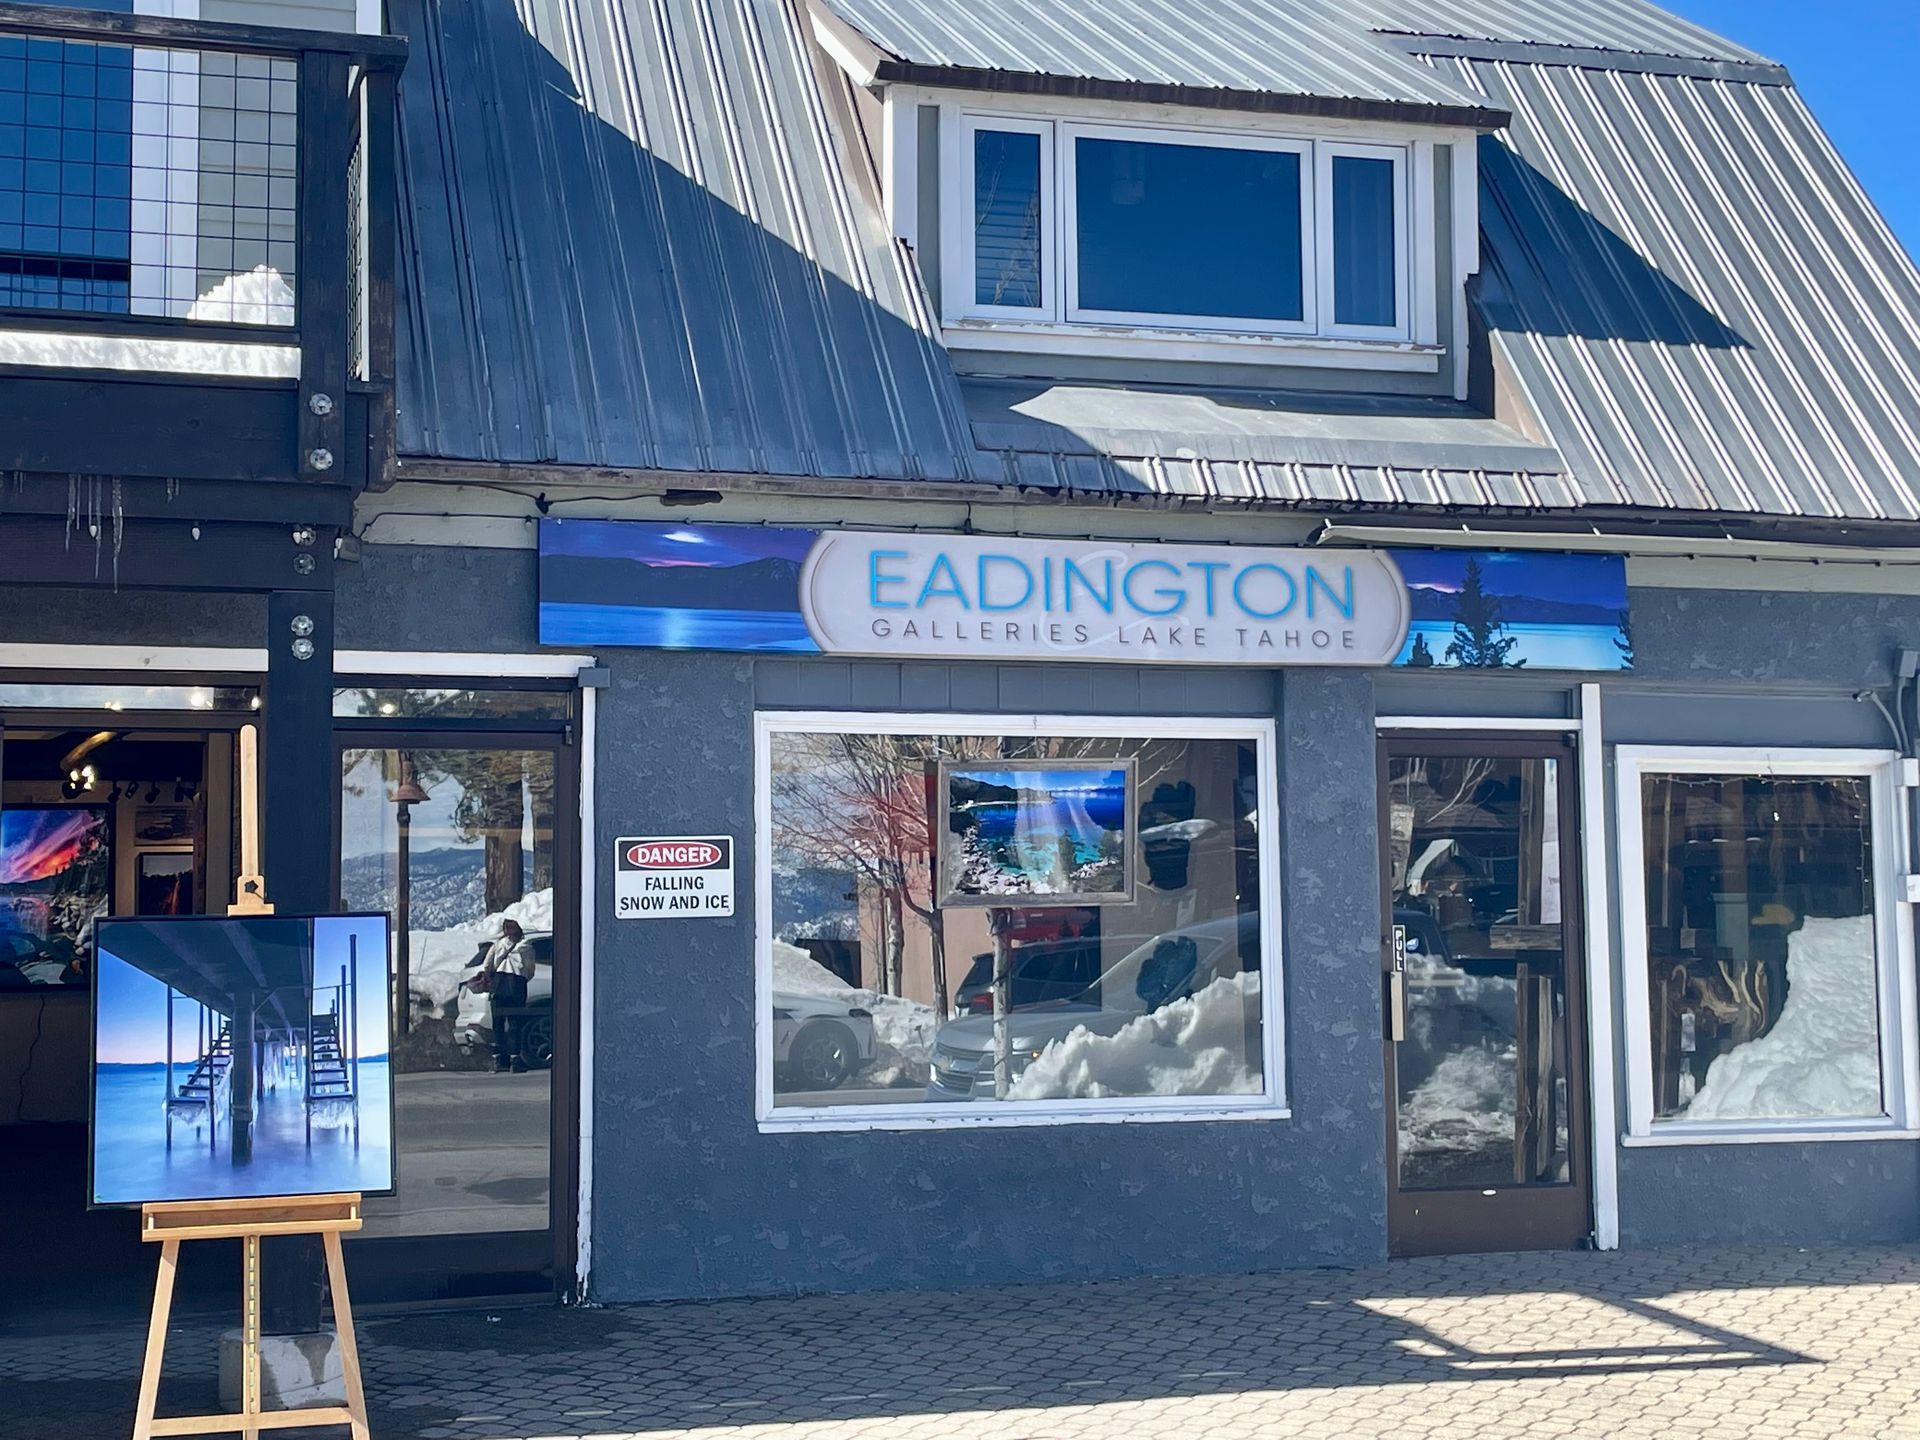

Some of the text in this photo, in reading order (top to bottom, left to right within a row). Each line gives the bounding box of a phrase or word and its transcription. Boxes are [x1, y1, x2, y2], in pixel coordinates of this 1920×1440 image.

[869, 550, 1353, 620] EADINGTON
[871, 618, 1354, 649] GALLERIES LAKE TAHOE
[637, 847, 712, 863] DANGER
[645, 876, 704, 891] FALLING
[620, 895, 729, 911] SNOW AND ICE
[1395, 929, 1403, 971] PULL
